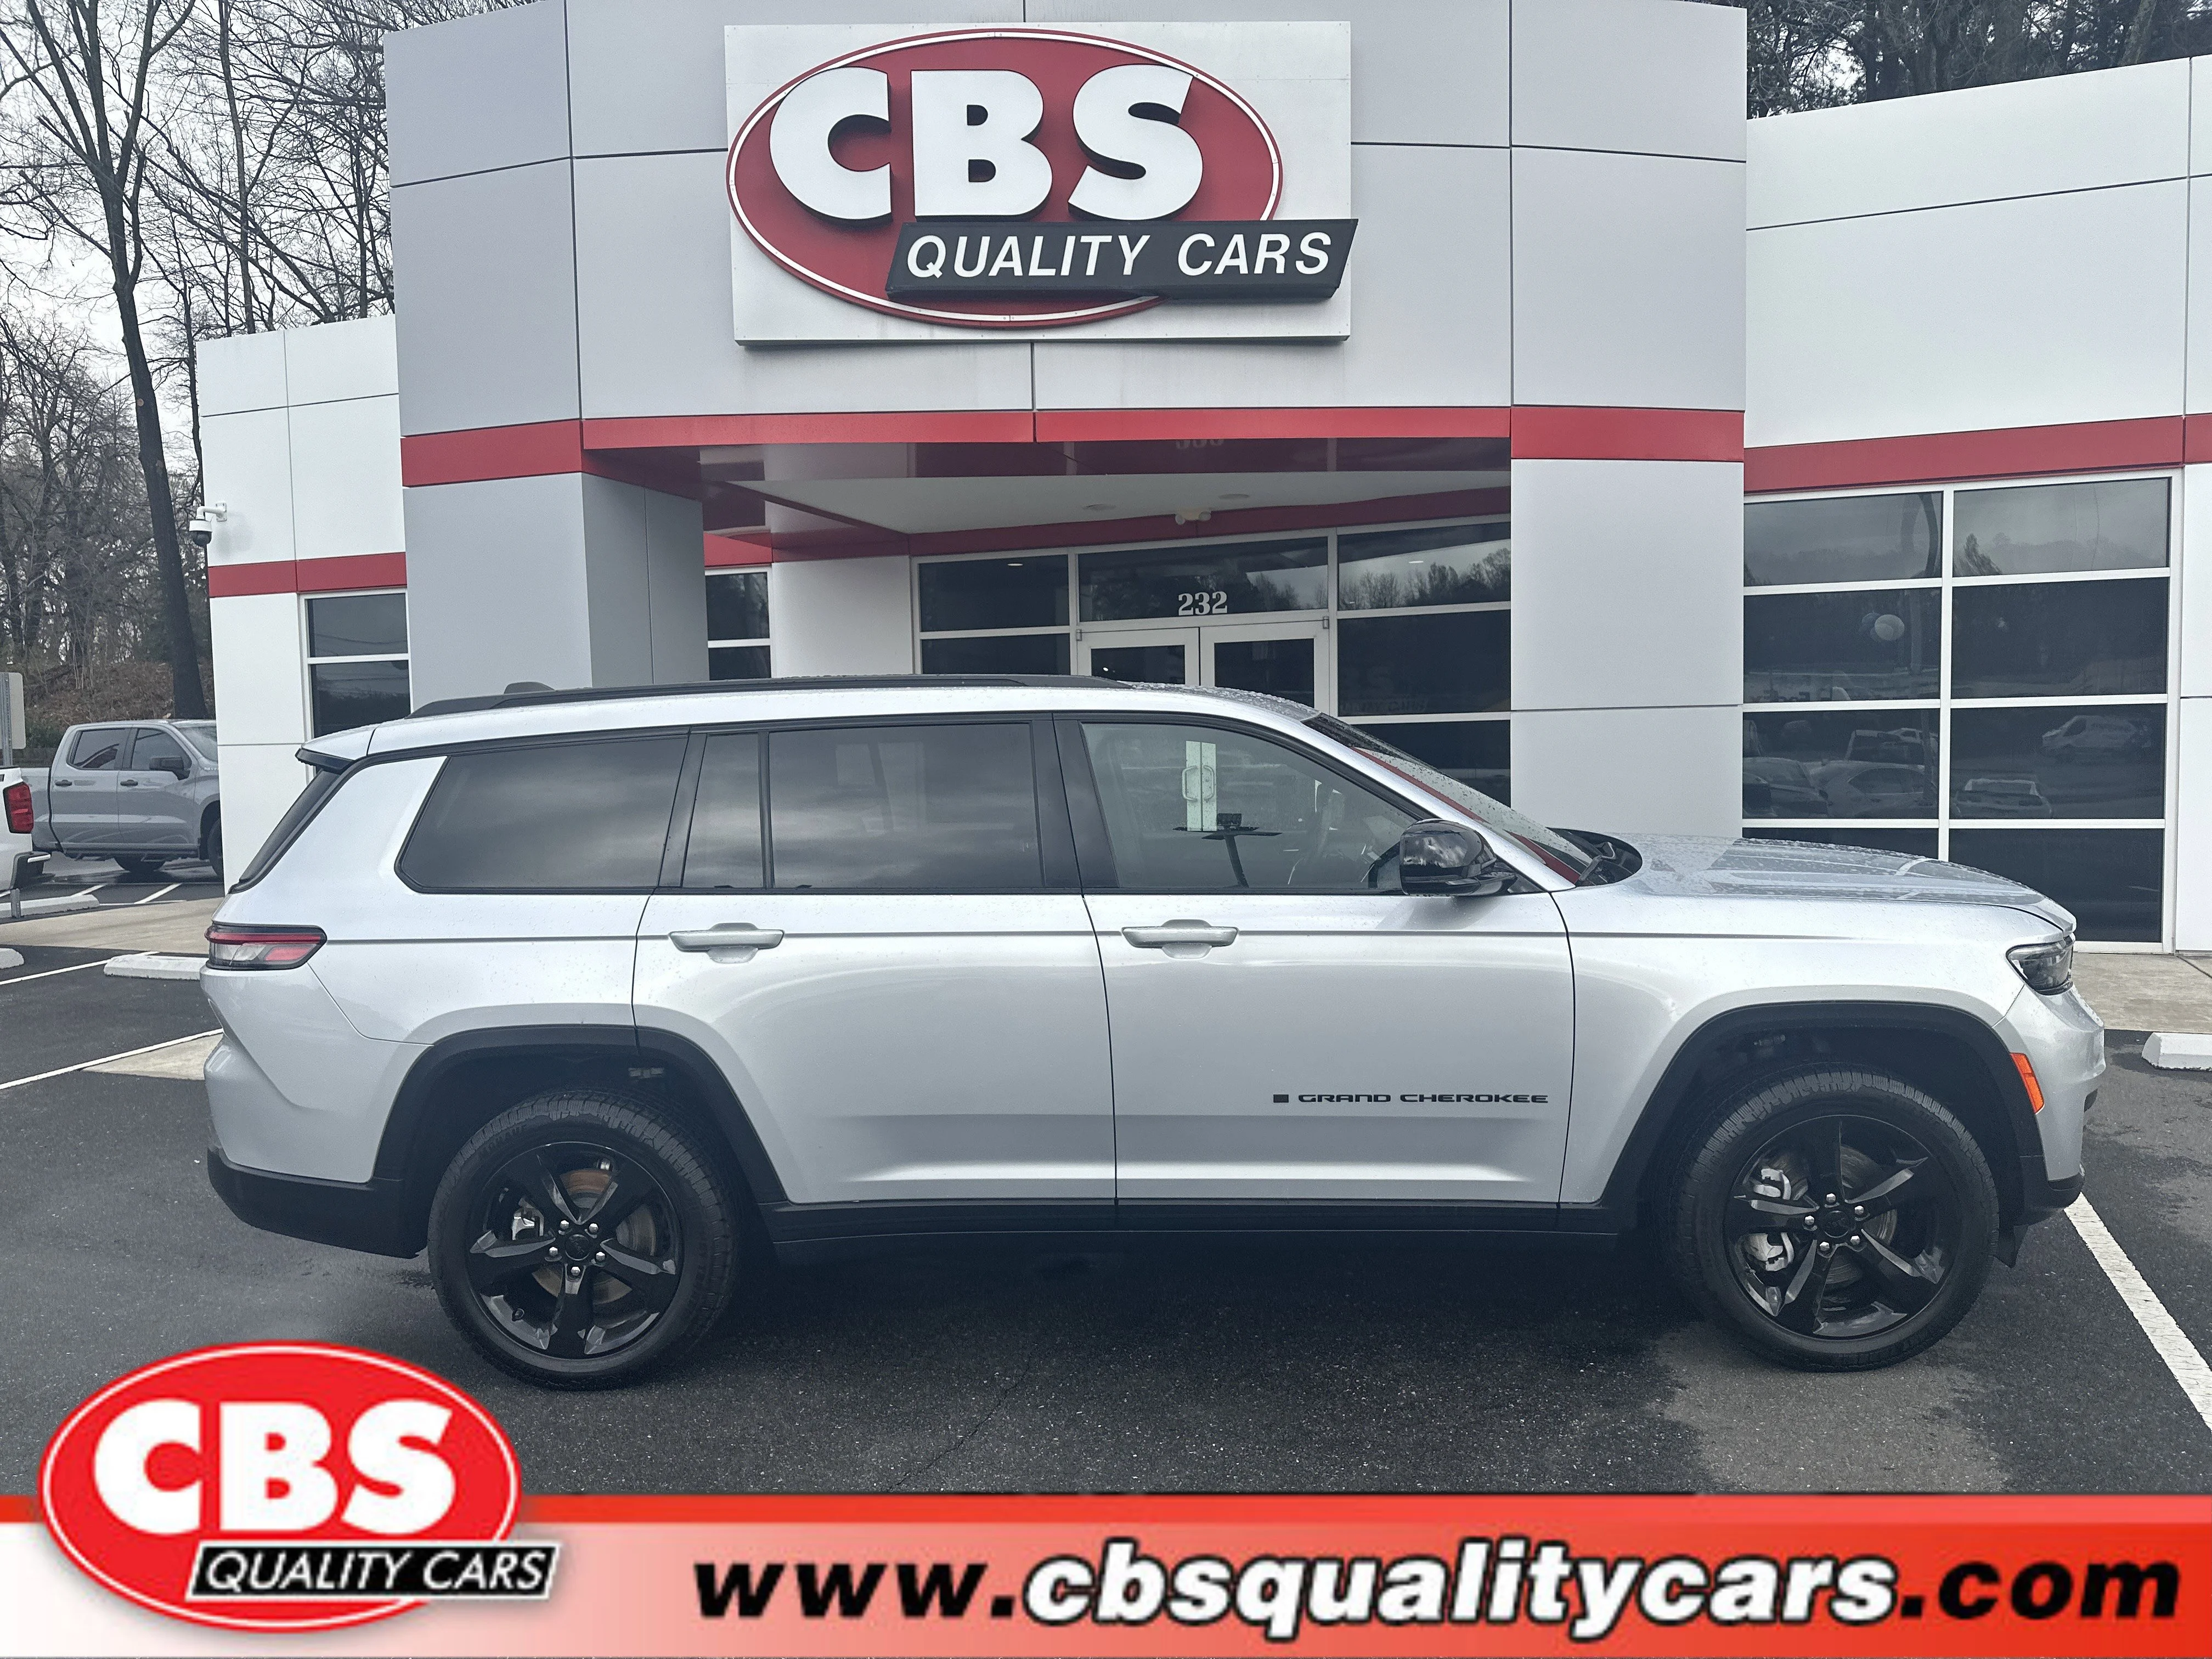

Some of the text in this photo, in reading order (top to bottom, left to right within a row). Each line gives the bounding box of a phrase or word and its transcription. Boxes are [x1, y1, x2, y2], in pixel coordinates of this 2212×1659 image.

[769, 64, 1204, 221] CBS
[906, 232, 1331, 278] QUALITY CARS
[1178, 591, 1227, 616] 232
[1299, 1094, 1549, 1103] GRAND CHEROKEE
